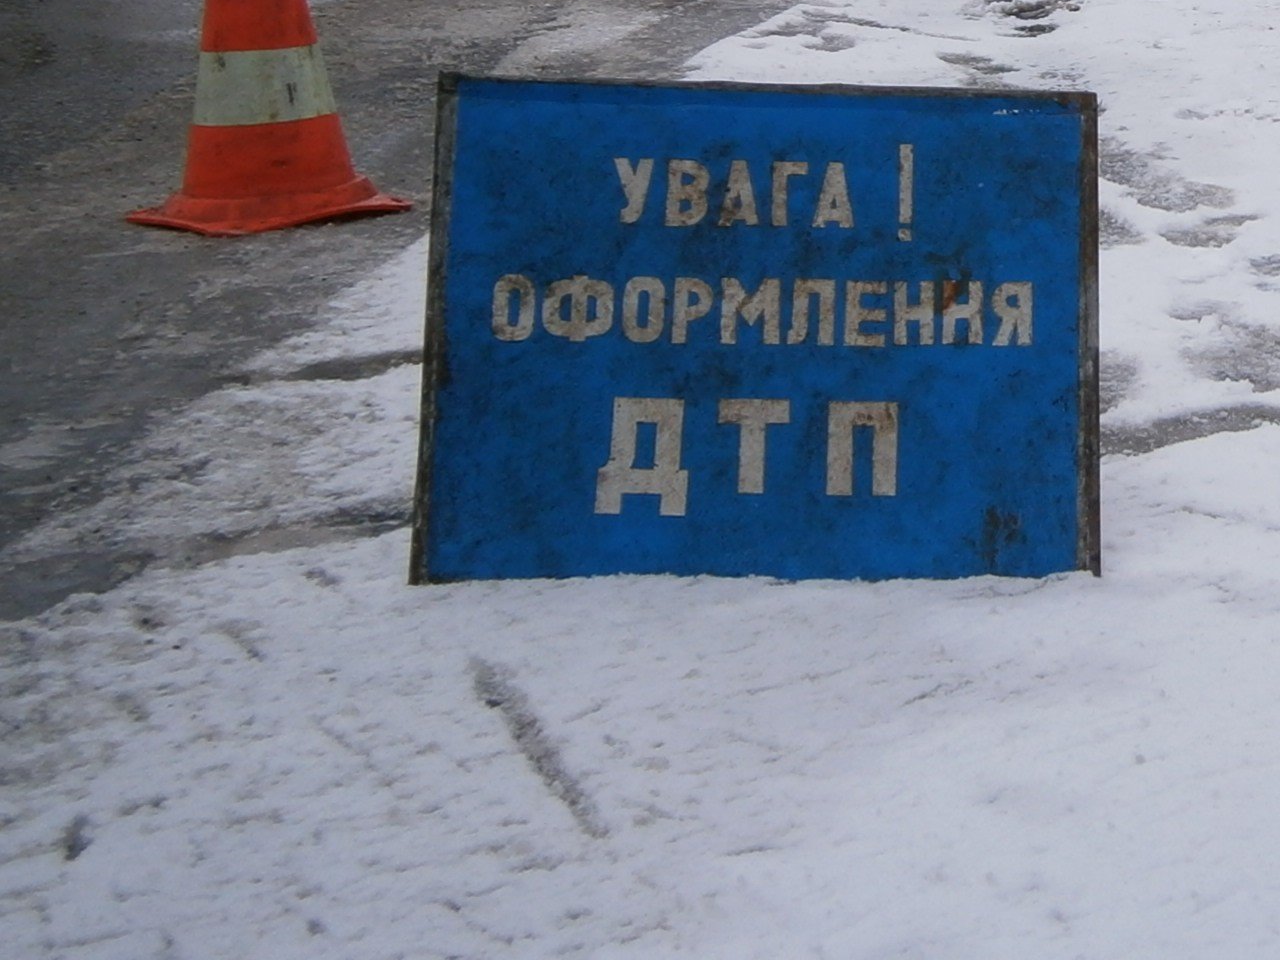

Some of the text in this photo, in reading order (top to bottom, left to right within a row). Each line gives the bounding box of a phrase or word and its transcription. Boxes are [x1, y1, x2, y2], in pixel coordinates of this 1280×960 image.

[614, 157, 853, 228] УВАГА
[491, 274, 1033, 346] ОФОРМЛЕННЯ
[594, 397, 899, 516] ДТП
